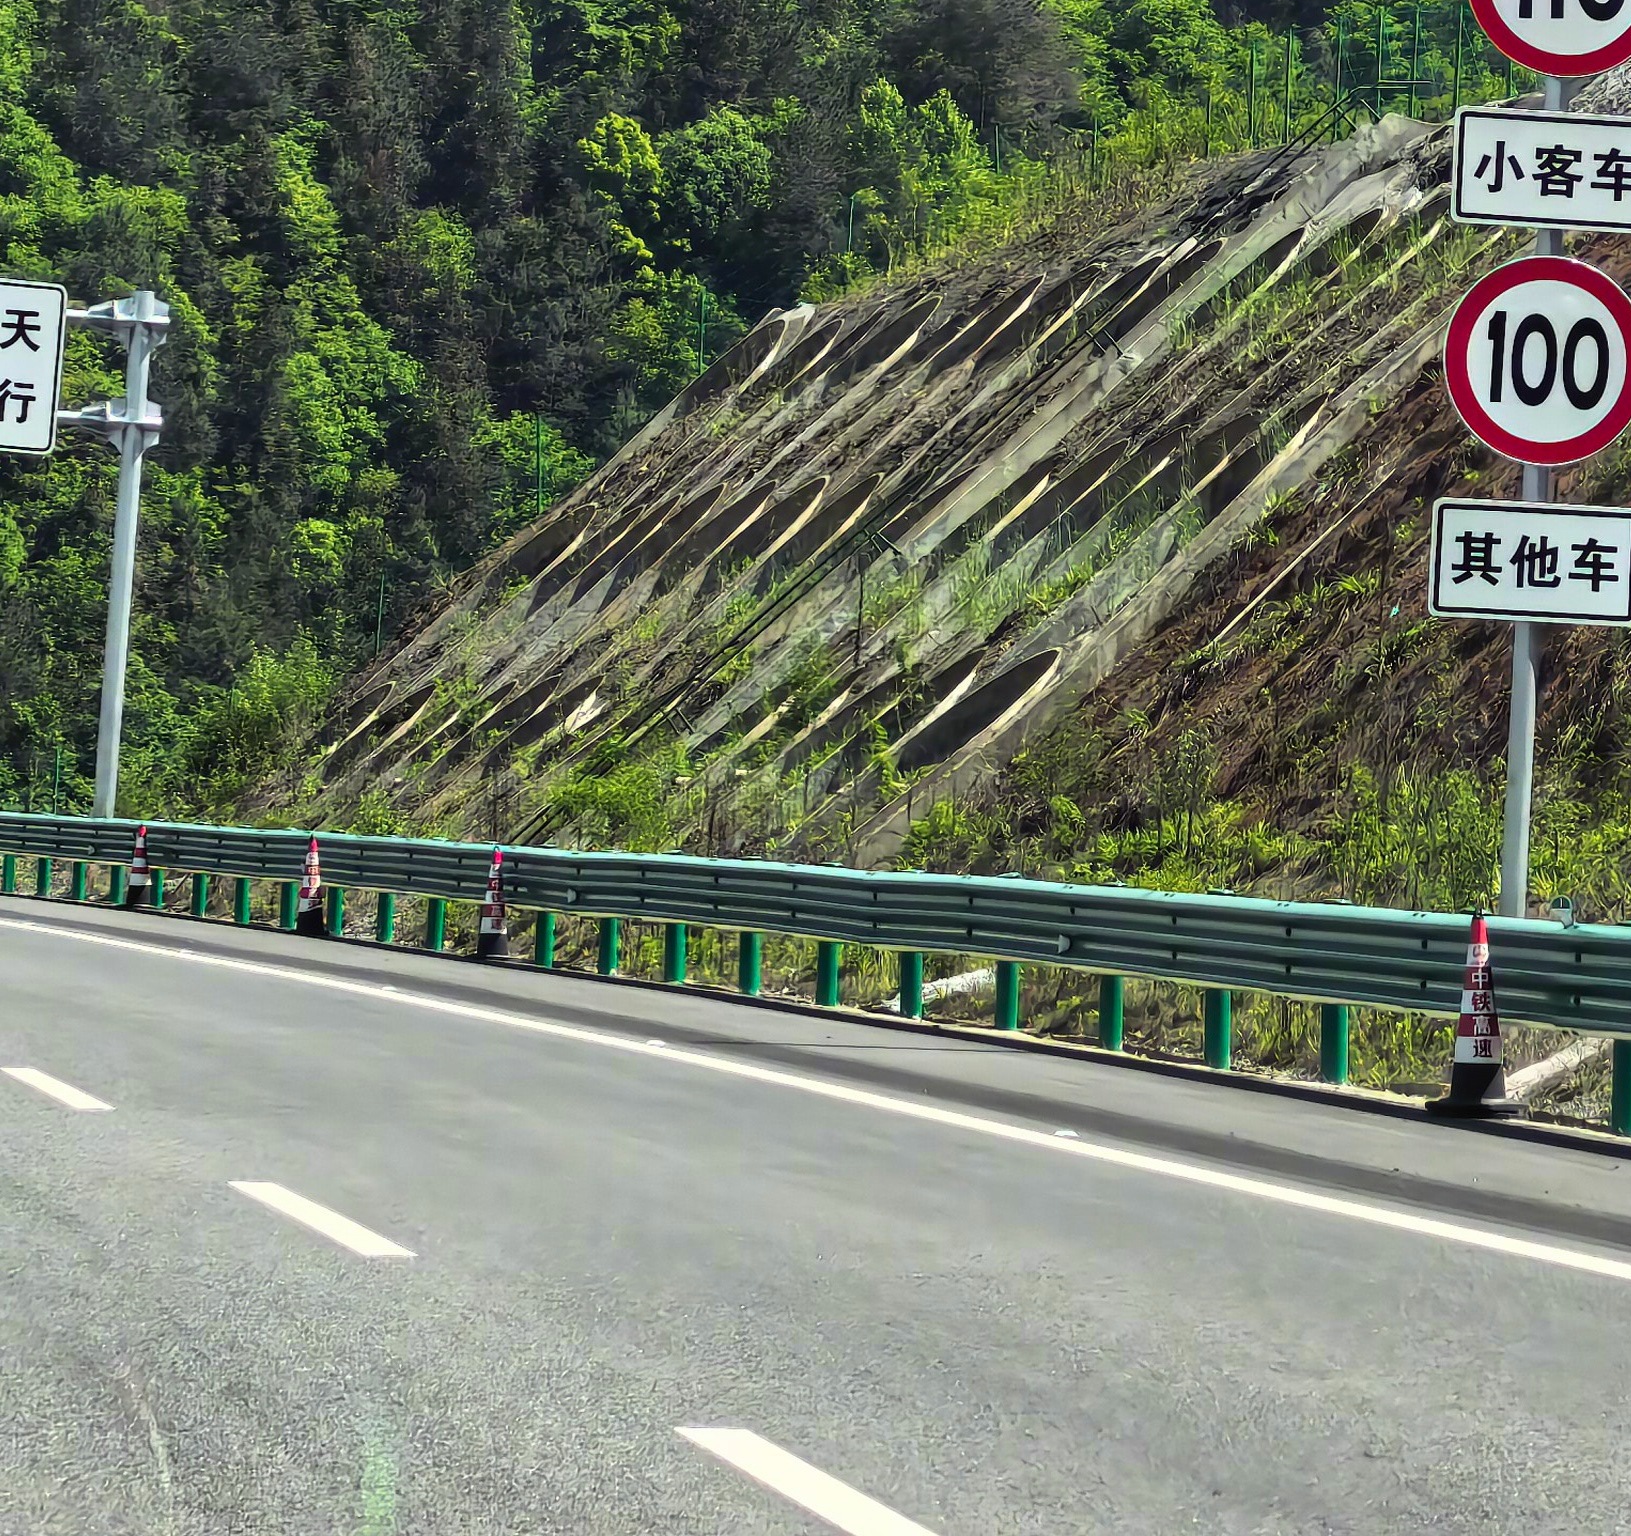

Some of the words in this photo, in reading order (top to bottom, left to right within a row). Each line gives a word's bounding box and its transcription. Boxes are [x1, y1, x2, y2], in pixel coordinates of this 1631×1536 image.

[0, 309, 41, 352] 天
[1487, 310, 1610, 412] 100
[0, 378, 36, 424] 行
[1451, 530, 1619, 593] 其他车
[1471, 967, 1493, 1058] 中铁高速
